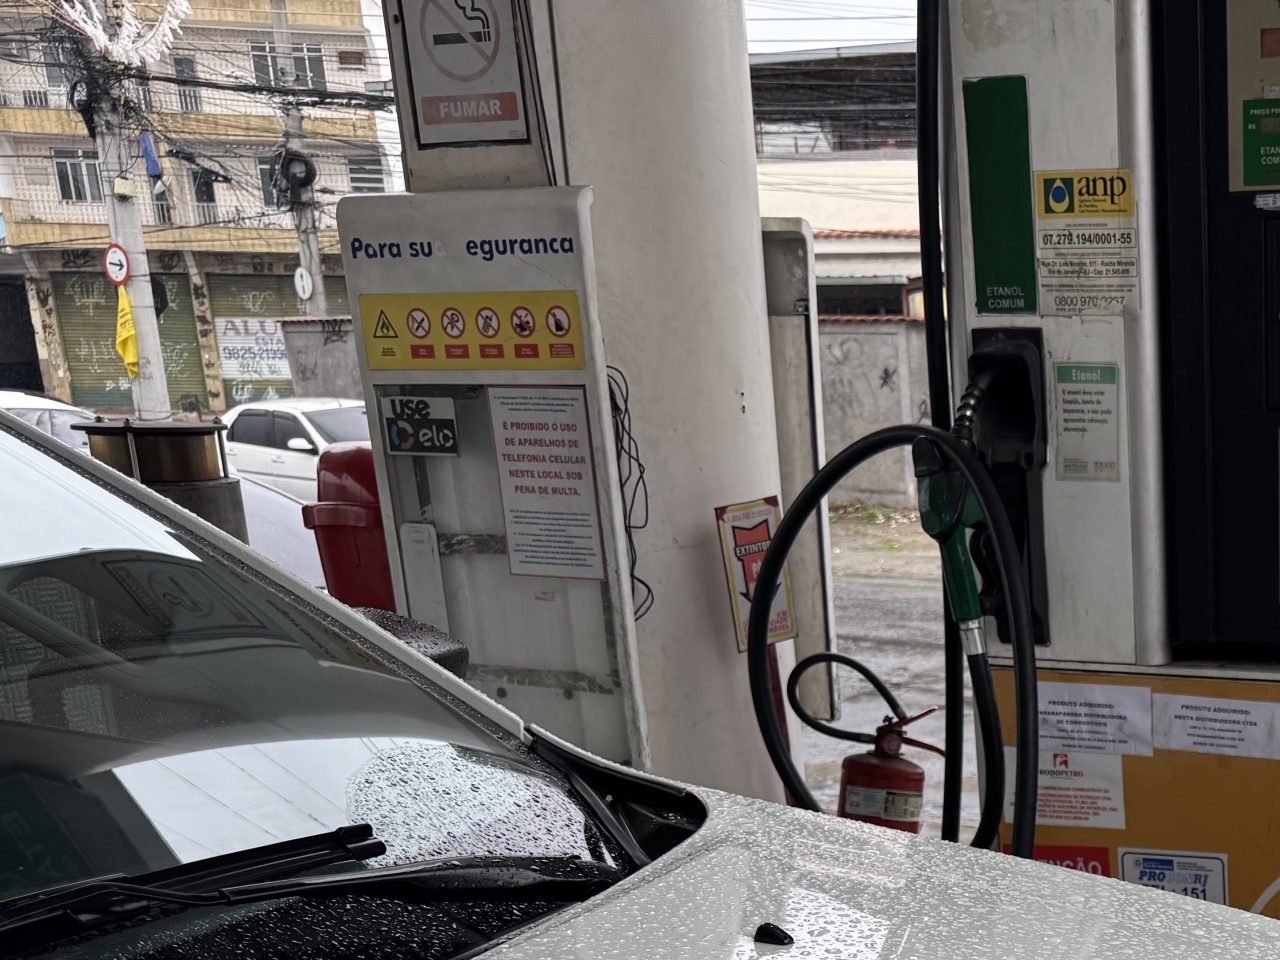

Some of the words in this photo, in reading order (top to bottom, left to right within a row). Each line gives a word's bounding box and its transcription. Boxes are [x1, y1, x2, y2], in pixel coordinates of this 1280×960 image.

[439, 99, 502, 118] FUMAR
[1078, 176, 1127, 206] anp
[351, 237, 402, 260] Para
[986, 286, 1025, 297] ETANOL
[988, 298, 1025, 309] COMUM
[1054, 296, 1078, 307] 0800
[1072, 368, 1101, 381] Etanol
[503, 420, 509, 431] É
[510, 422, 550, 432] PROIBIDO
[551, 423, 558, 432] O
[560, 423, 577, 433] USO
[419, 424, 454, 448] elo
[505, 438, 516, 447] DE
[518, 438, 567, 448] APARELHOS
[568, 439, 579, 448] DE
[502, 453, 547, 464] TELEFONIA
[549, 454, 586, 465] CELULAR
[509, 470, 536, 479] NESTE
[538, 470, 564, 480] LOCAL
[566, 471, 583, 480] SOB
[515, 484, 536, 494] PENA
[538, 485, 549, 495] DE
[551, 486, 581, 496] MULTA.
